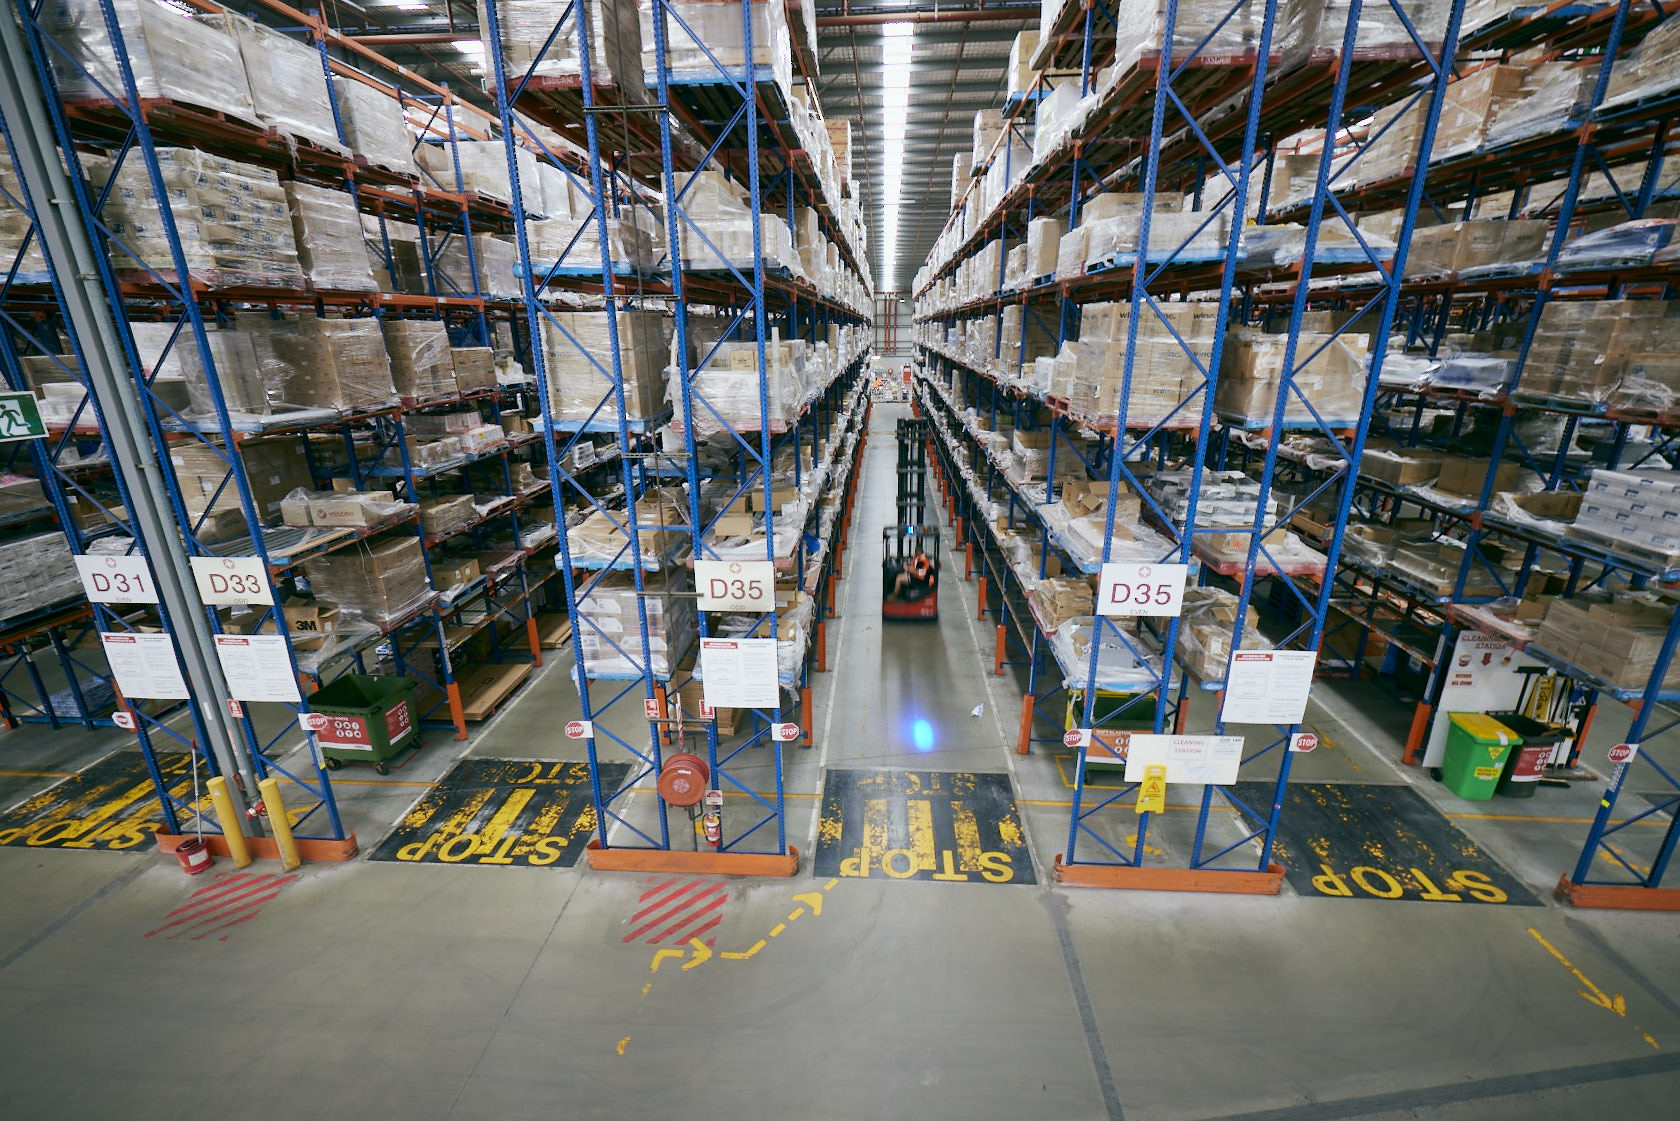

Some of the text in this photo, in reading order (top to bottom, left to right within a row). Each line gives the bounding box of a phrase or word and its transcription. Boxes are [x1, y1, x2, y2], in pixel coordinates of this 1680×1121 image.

[91, 573, 145, 593] D31
[208, 573, 261, 594] D33
[710, 578, 763, 600] D35
[1110, 583, 1172, 605] D35
[296, 620, 318, 631] 3M
[1461, 634, 1499, 642] CLEANIN
[308, 717, 327, 726] STOP
[566, 726, 584, 735] STOP
[780, 727, 798, 736] STOP
[1066, 733, 1081, 742] STOP
[1173, 738, 1205, 746] CLEANING
[1297, 738, 1317, 747] STOP
[1610, 748, 1630, 757] STOP
[0, 820, 162, 850] STOP
[396, 833, 569, 866] STOP
[839, 848, 1014, 883] STOP
[1311, 863, 1508, 903] STOP
